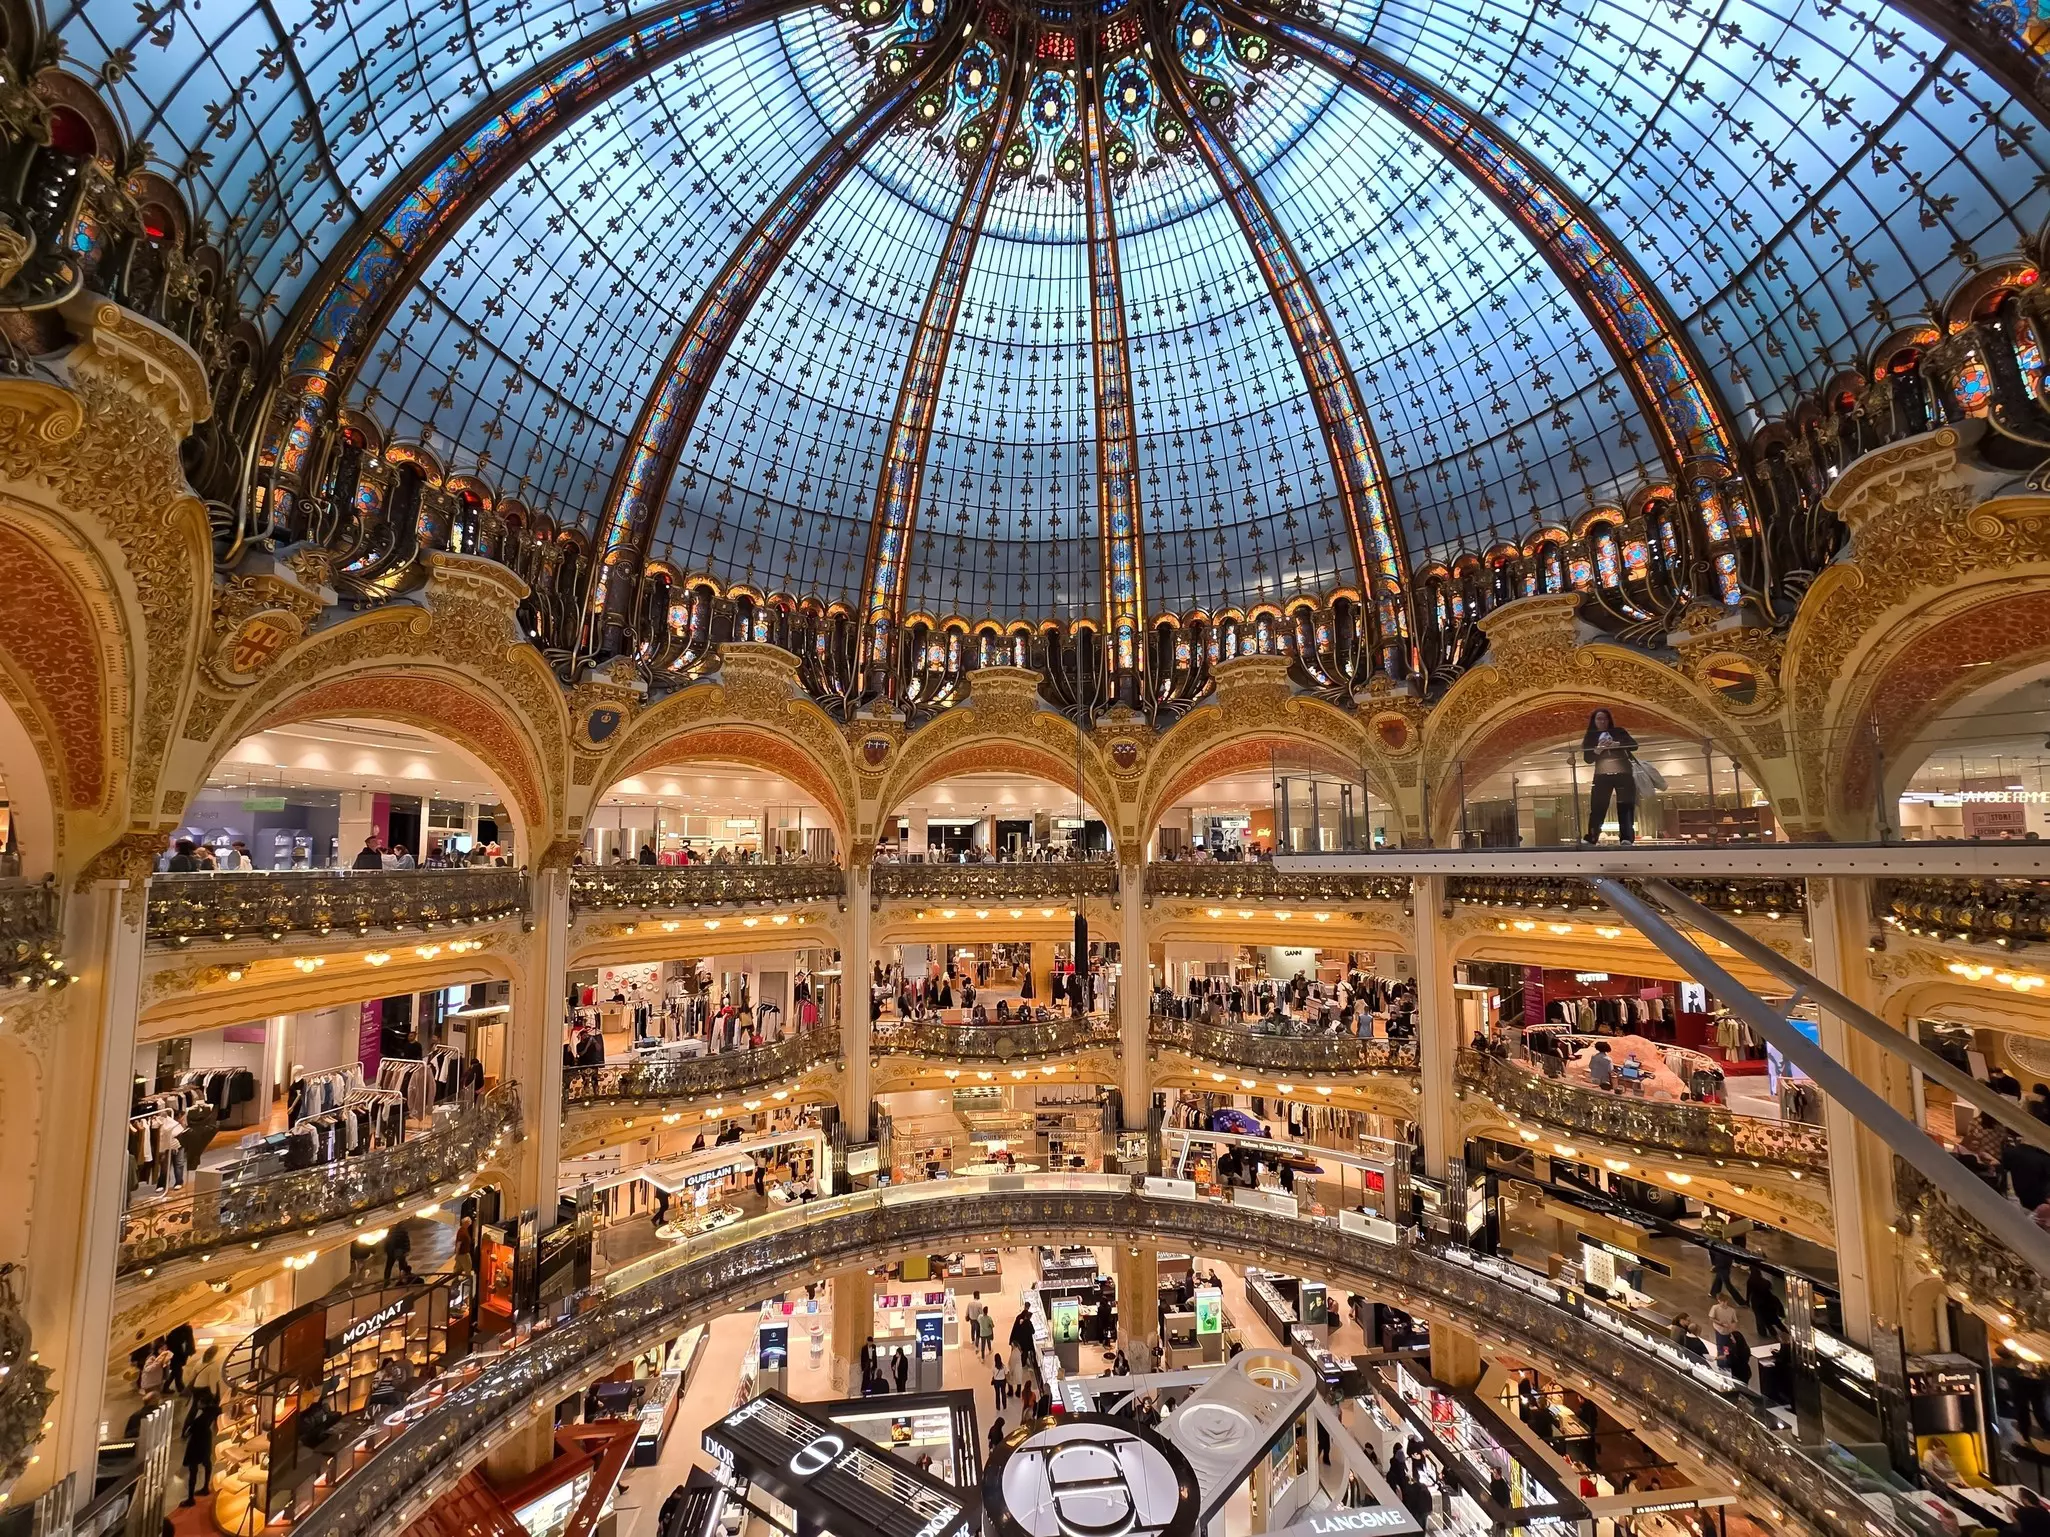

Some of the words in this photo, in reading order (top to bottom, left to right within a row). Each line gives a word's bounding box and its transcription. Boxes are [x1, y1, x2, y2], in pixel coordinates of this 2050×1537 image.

[1977, 791, 2012, 803] MODE
[1576, 973, 1608, 982] SYSTEM
[688, 1166, 732, 1186] GUERLAIN
[1602, 1243, 1641, 1264] CHANEL
[342, 1300, 404, 1345] MOYNAT
[724, 1399, 768, 1427] DIOR
[705, 1436, 735, 1469] DIOR
[1645, 1504, 1670, 1513] MALONE
[1670, 1502, 1695, 1510] LONDON
